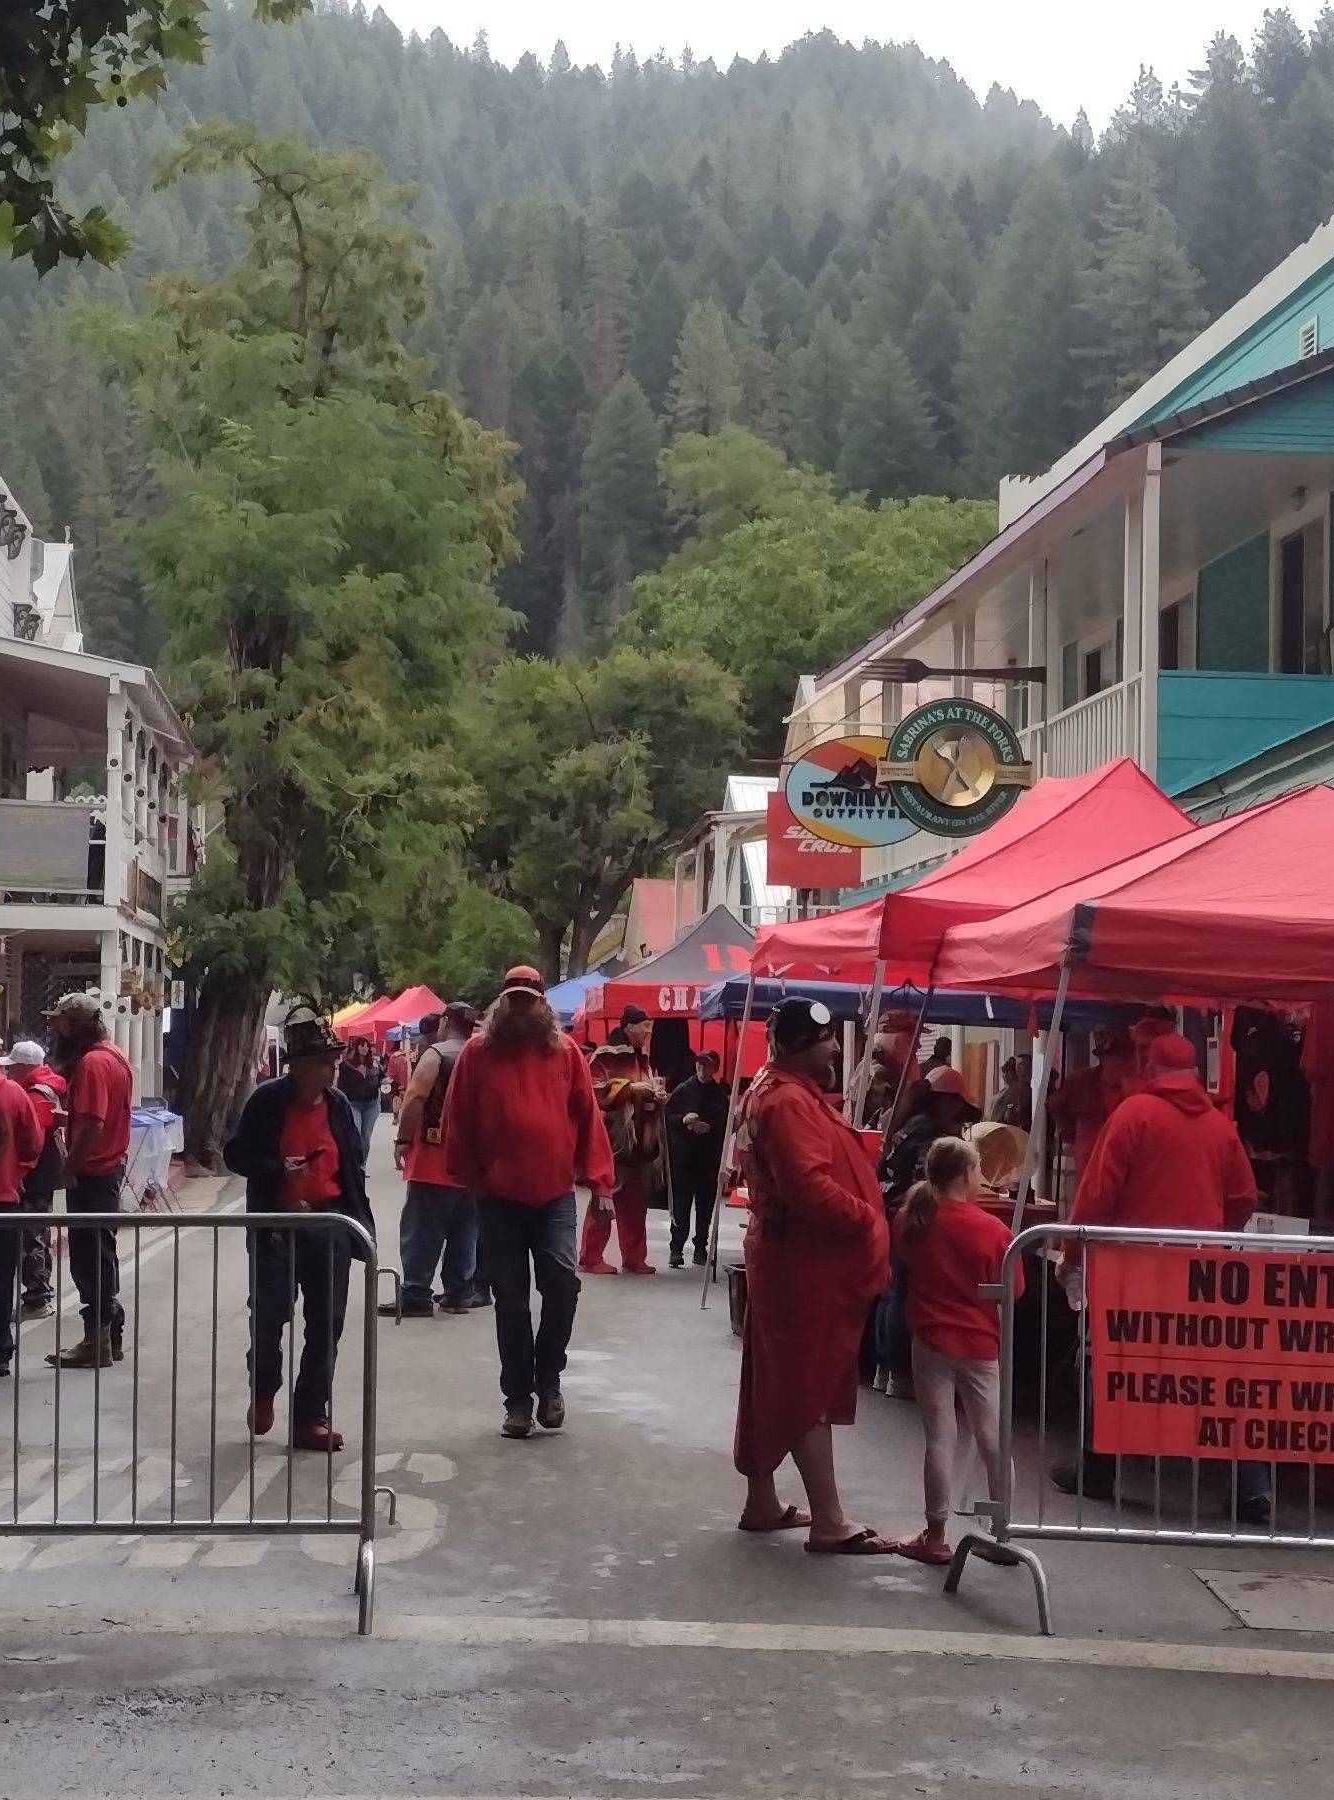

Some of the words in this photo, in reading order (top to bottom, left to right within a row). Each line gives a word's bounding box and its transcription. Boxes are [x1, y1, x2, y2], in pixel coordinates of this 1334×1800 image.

[897, 709, 945, 759] SABRINA'S
[946, 707, 964, 719] AT
[965, 708, 990, 728] THE
[987, 723, 1015, 763] FORKS
[900, 784, 950, 827] RESTAURANT
[1187, 1259, 1250, 1305] NO
[1105, 1309, 1269, 1350] WITHOUT
[1106, 1371, 1216, 1407] PLEASE
[1225, 1376, 1284, 1410] GET
[1197, 1416, 1237, 1447] AT
